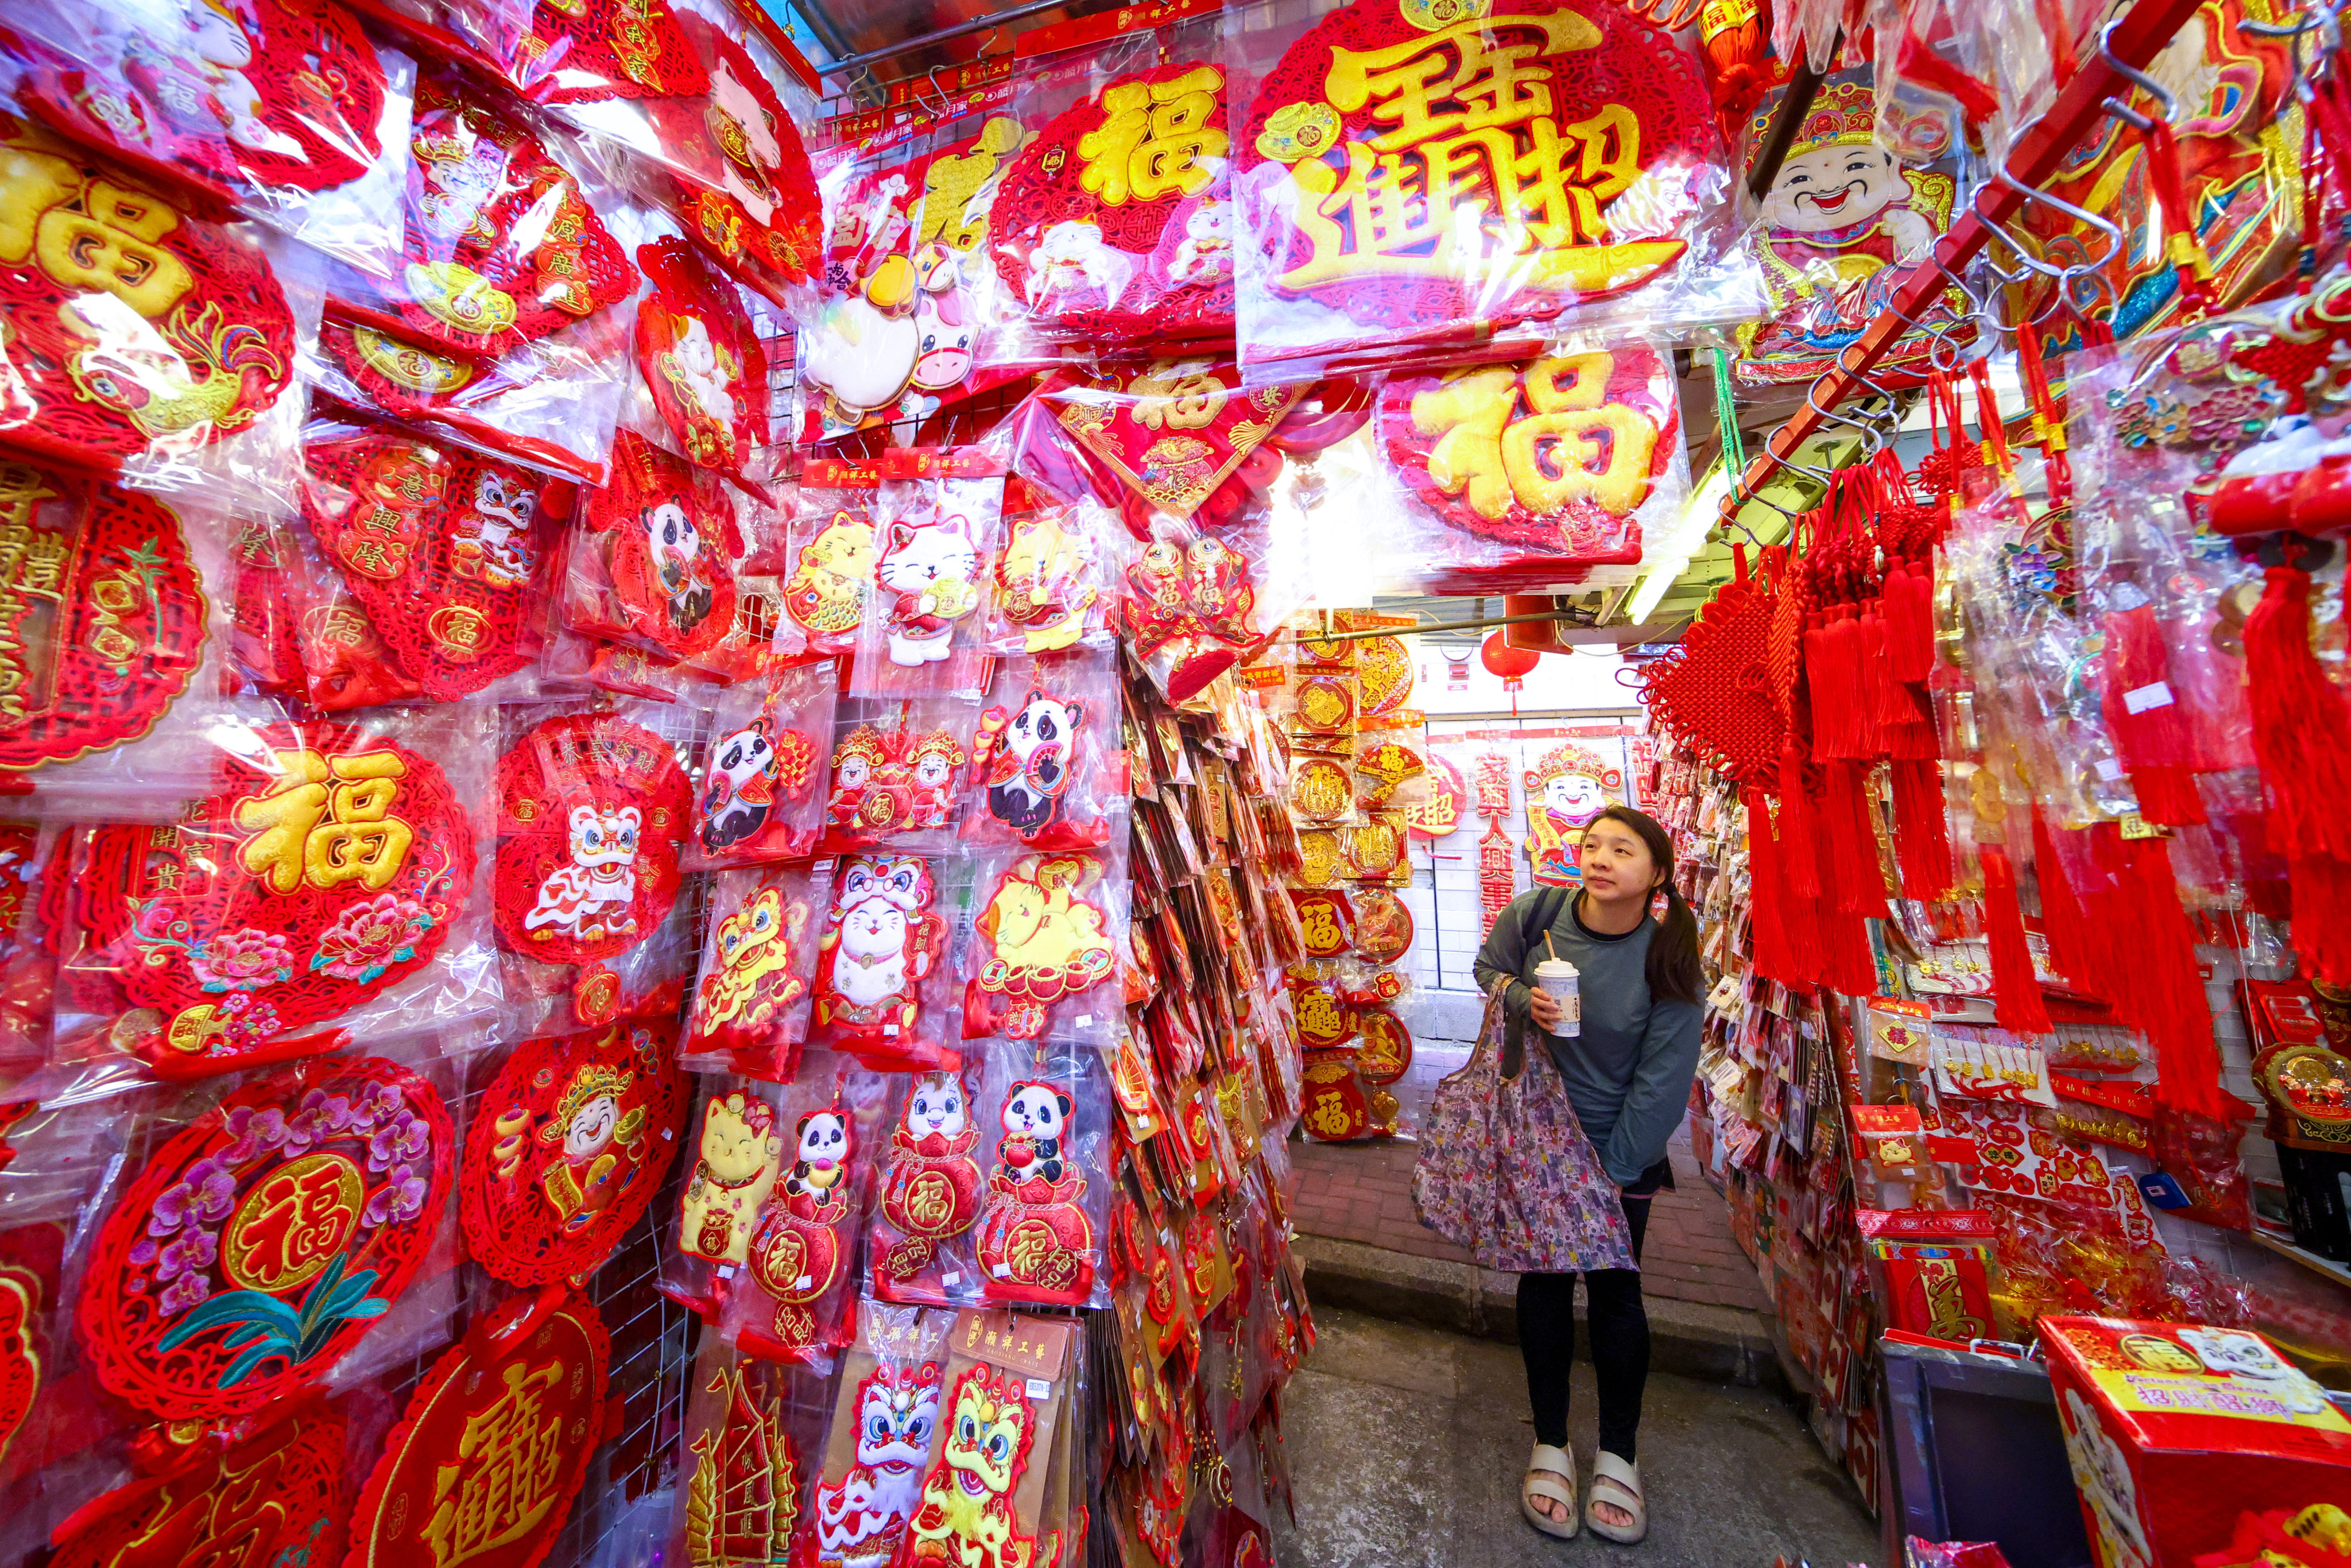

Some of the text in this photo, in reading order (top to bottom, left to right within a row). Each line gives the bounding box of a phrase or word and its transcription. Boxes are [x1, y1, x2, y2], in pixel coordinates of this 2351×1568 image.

[728, 131, 743, 152] 福
[1078, 66, 1230, 206] 福
[1299, 127, 1320, 148] 福
[455, 297, 478, 319] 福
[1410, 353, 1656, 520] 福
[1163, 469, 1190, 490] 福
[940, 595, 955, 611] 福
[1014, 594, 1031, 611] 福
[328, 612, 367, 648] 福
[446, 613, 478, 645] 福
[561, 738, 656, 774] 恭喜發財
[1378, 745, 1405, 772] 福
[231, 748, 415, 895] 福
[518, 804, 534, 820] 福
[653, 810, 668, 824] 福
[871, 796, 892, 823] 福
[1301, 904, 1341, 949] 福
[1314, 1091, 1351, 1135] 福
[912, 1179, 946, 1222] 福
[237, 1160, 353, 1283] 福
[768, 1236, 801, 1284] 福
[1011, 1228, 1049, 1277] 福
[2128, 1338, 2200, 1373] 福
